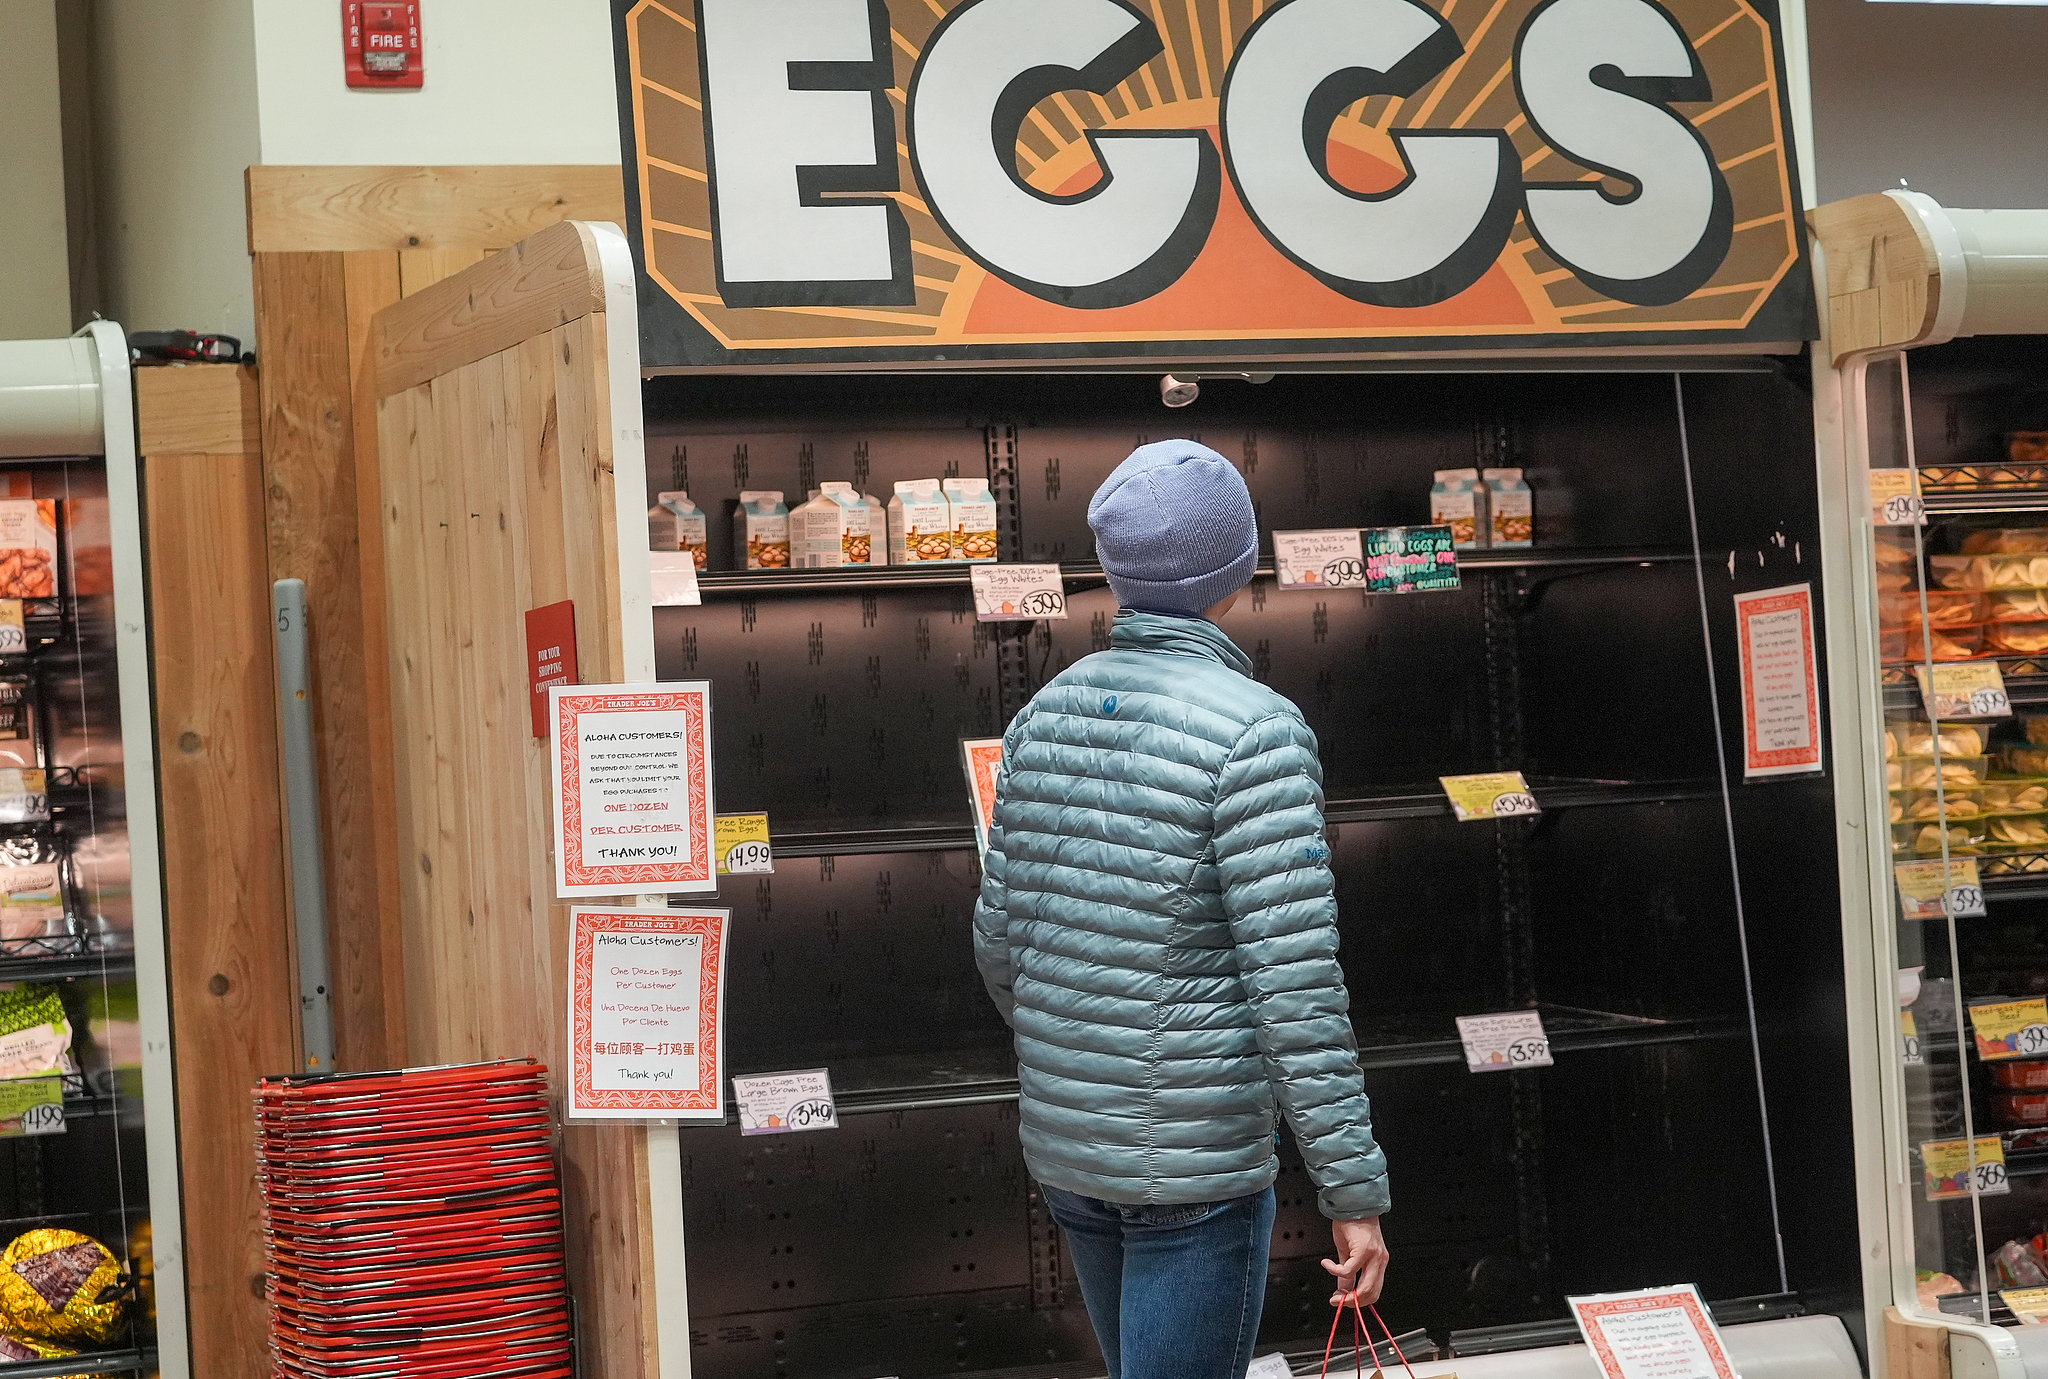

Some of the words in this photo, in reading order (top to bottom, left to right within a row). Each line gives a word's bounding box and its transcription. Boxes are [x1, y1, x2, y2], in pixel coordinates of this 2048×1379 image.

[349, 3, 359, 48] FIRE
[407, 4, 418, 48] FIRE
[370, 34, 404, 48] FIRE
[702, 0, 1733, 307] EGGS
[1407, 539, 1434, 552] EGGS
[989, 575, 1009, 584] Egg
[1010, 574, 1044, 583] Whites
[278, 607, 290, 632] 5
[584, 733, 617, 742] ALOHA
[618, 731, 683, 740] CUSTOMERS!
[617, 751, 678, 759] CIRCUMSTANCES
[590, 765, 618, 773] BEYOND
[662, 774, 681, 783] YOUR
[603, 804, 627, 812] ONE
[629, 802, 669, 811] DOZEN
[738, 817, 766, 826] Range
[590, 826, 616, 835] PER
[618, 823, 684, 834] CUSTOMER
[738, 825, 759, 834] Eggs
[598, 847, 645, 858] THANK
[648, 845, 677, 857] YOU!
[598, 934, 627, 945] Aloha
[630, 935, 699, 946] Customers!
[610, 966, 630, 975] One
[632, 967, 659, 975] Dozen
[661, 967, 683, 977] Eggs
[615, 981, 633, 989] Per
[634, 982, 677, 990] Customer
[600, 1003, 615, 1012] Una
[617, 1004, 649, 1012] Docena
[651, 1004, 664, 1012] De
[665, 1004, 690, 1012] Huevo
[622, 1017, 638, 1026] Por
[639, 1018, 670, 1026] Cliente
[594, 1042, 695, 1055] 每位顾客一打鸡蛋
[617, 1068, 650, 1079] Thank
[653, 1068, 674, 1082] you!
[743, 1080, 772, 1089] Dozen
[772, 1078, 795, 1086] Cage
[740, 1089, 768, 1098] Large
[769, 1086, 799, 1096] Brown
[800, 1083, 824, 1093] Eggs
